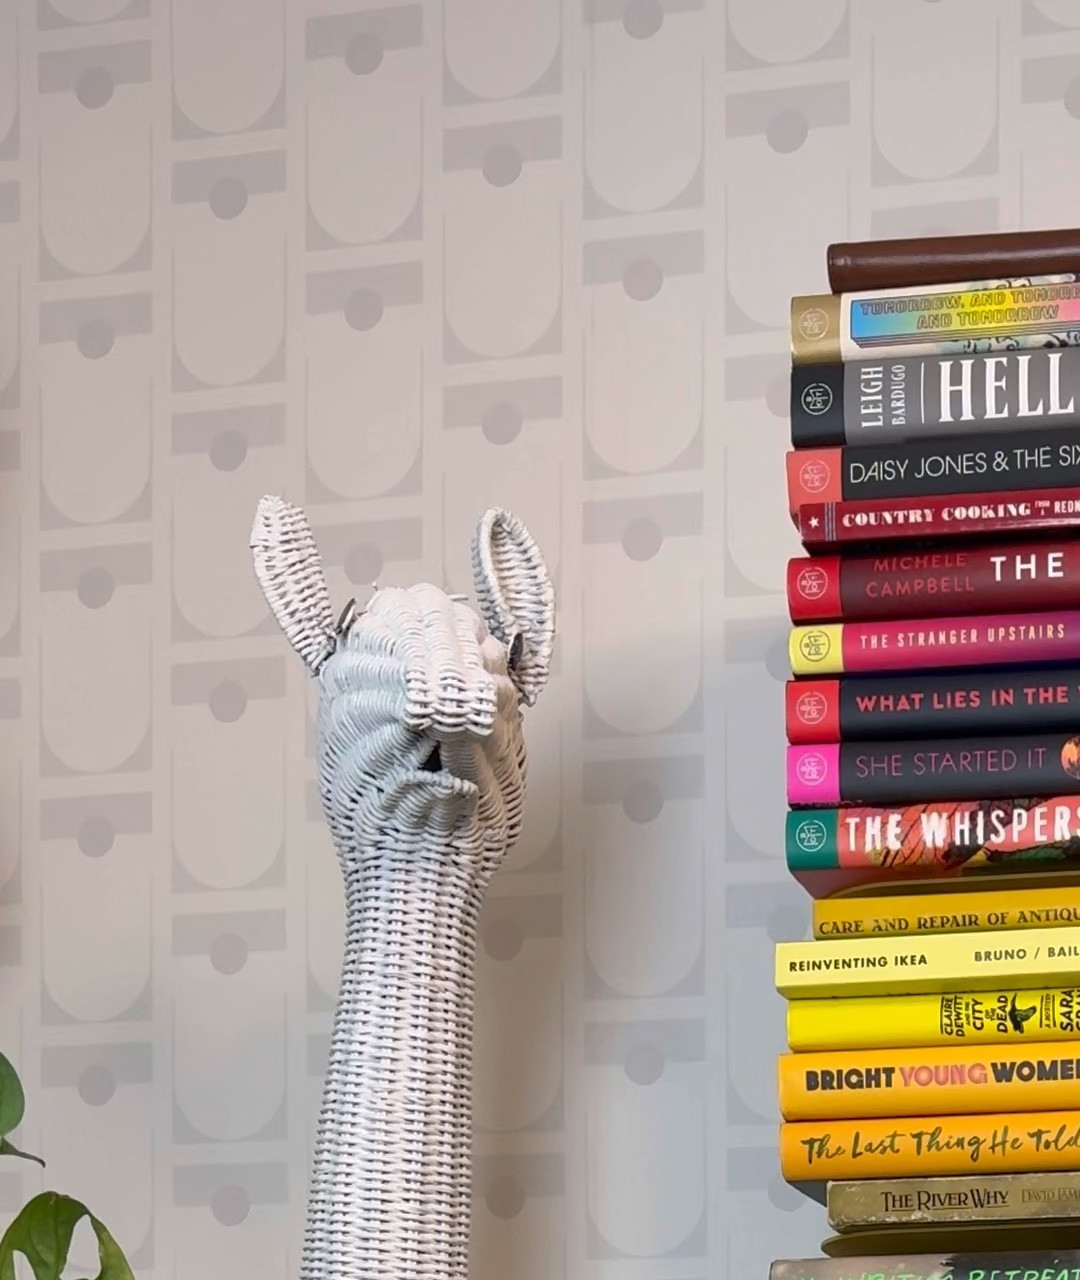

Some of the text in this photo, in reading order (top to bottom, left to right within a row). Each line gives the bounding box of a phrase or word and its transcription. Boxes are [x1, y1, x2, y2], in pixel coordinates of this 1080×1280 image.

[861, 367, 883, 428] LEIGH
[891, 364, 906, 426] BARDUGO
[939, 353, 1075, 422] HELL
[850, 459, 909, 484] DAISY
[915, 452, 987, 479] JONES
[993, 452, 1009, 472] &
[1013, 447, 1052, 469] THE
[874, 553, 968, 571] MICHELE
[990, 552, 1064, 582] THE
[866, 577, 975, 598] CAMPBELL
[860, 624, 1066, 650] THE STRANGER UPSTAIRS
[856, 693, 924, 712] WHAT
[933, 691, 980, 710] LIES
[991, 688, 1014, 706] IN
[1023, 686, 1069, 704] THE
[856, 748, 1047, 778] SHE STARTED IT
[846, 814, 902, 852] THE
[819, 920, 864, 935] CARE
[872, 917, 909, 932] AND
[917, 913, 979, 929] REPAIR
[987, 912, 1009, 926] OF
[789, 954, 928, 972] REINVENTING IKEA
[1060, 990, 1074, 1032] SARA
[806, 1067, 895, 1091] BRIGHT
[900, 1063, 989, 1087] YOUNG
